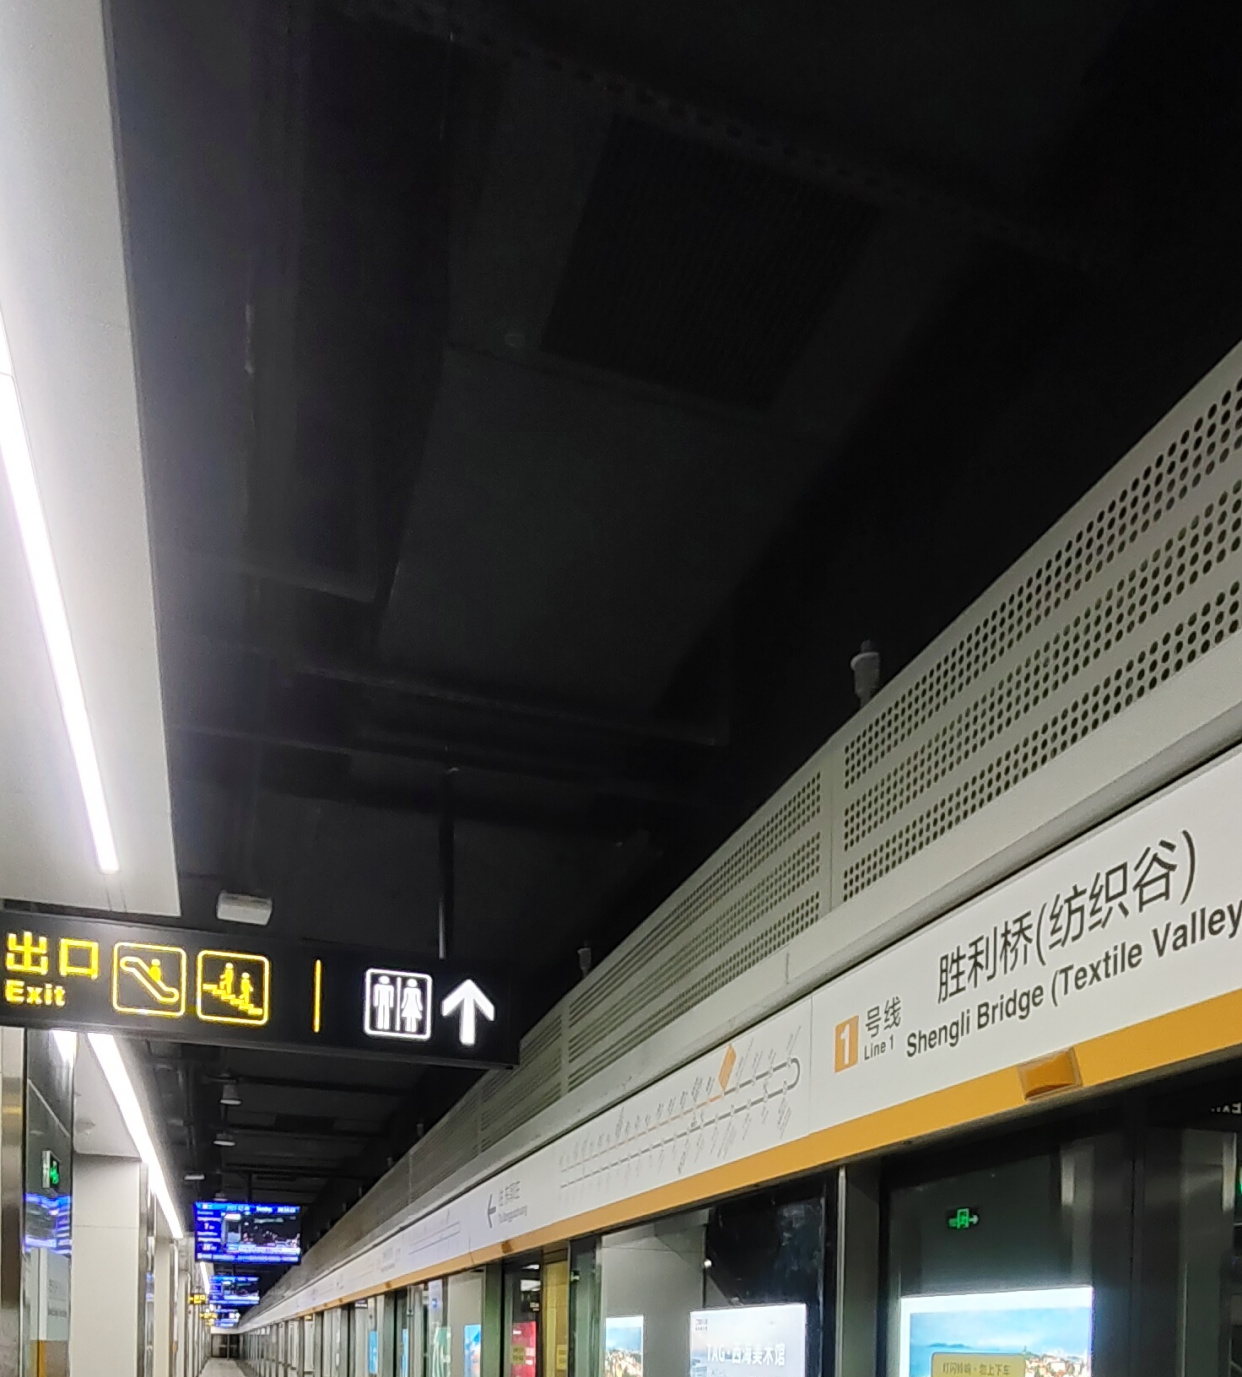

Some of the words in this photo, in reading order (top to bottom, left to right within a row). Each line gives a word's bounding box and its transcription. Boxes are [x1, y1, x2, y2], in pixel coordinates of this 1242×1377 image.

[938, 829, 1196, 1004] 胜利桥(纺织谷)
[5, 931, 99, 980] 出口
[905, 1011, 971, 1058] Shengli
[976, 983, 1044, 1031] Bridge
[1051, 941, 1143, 1008] (Textile
[1151, 898, 1242, 958] Valley
[5, 980, 66, 1007] Exit
[865, 996, 902, 1038] 号线
[863, 1039, 886, 1061] Line
[889, 1034, 894, 1051] 1
